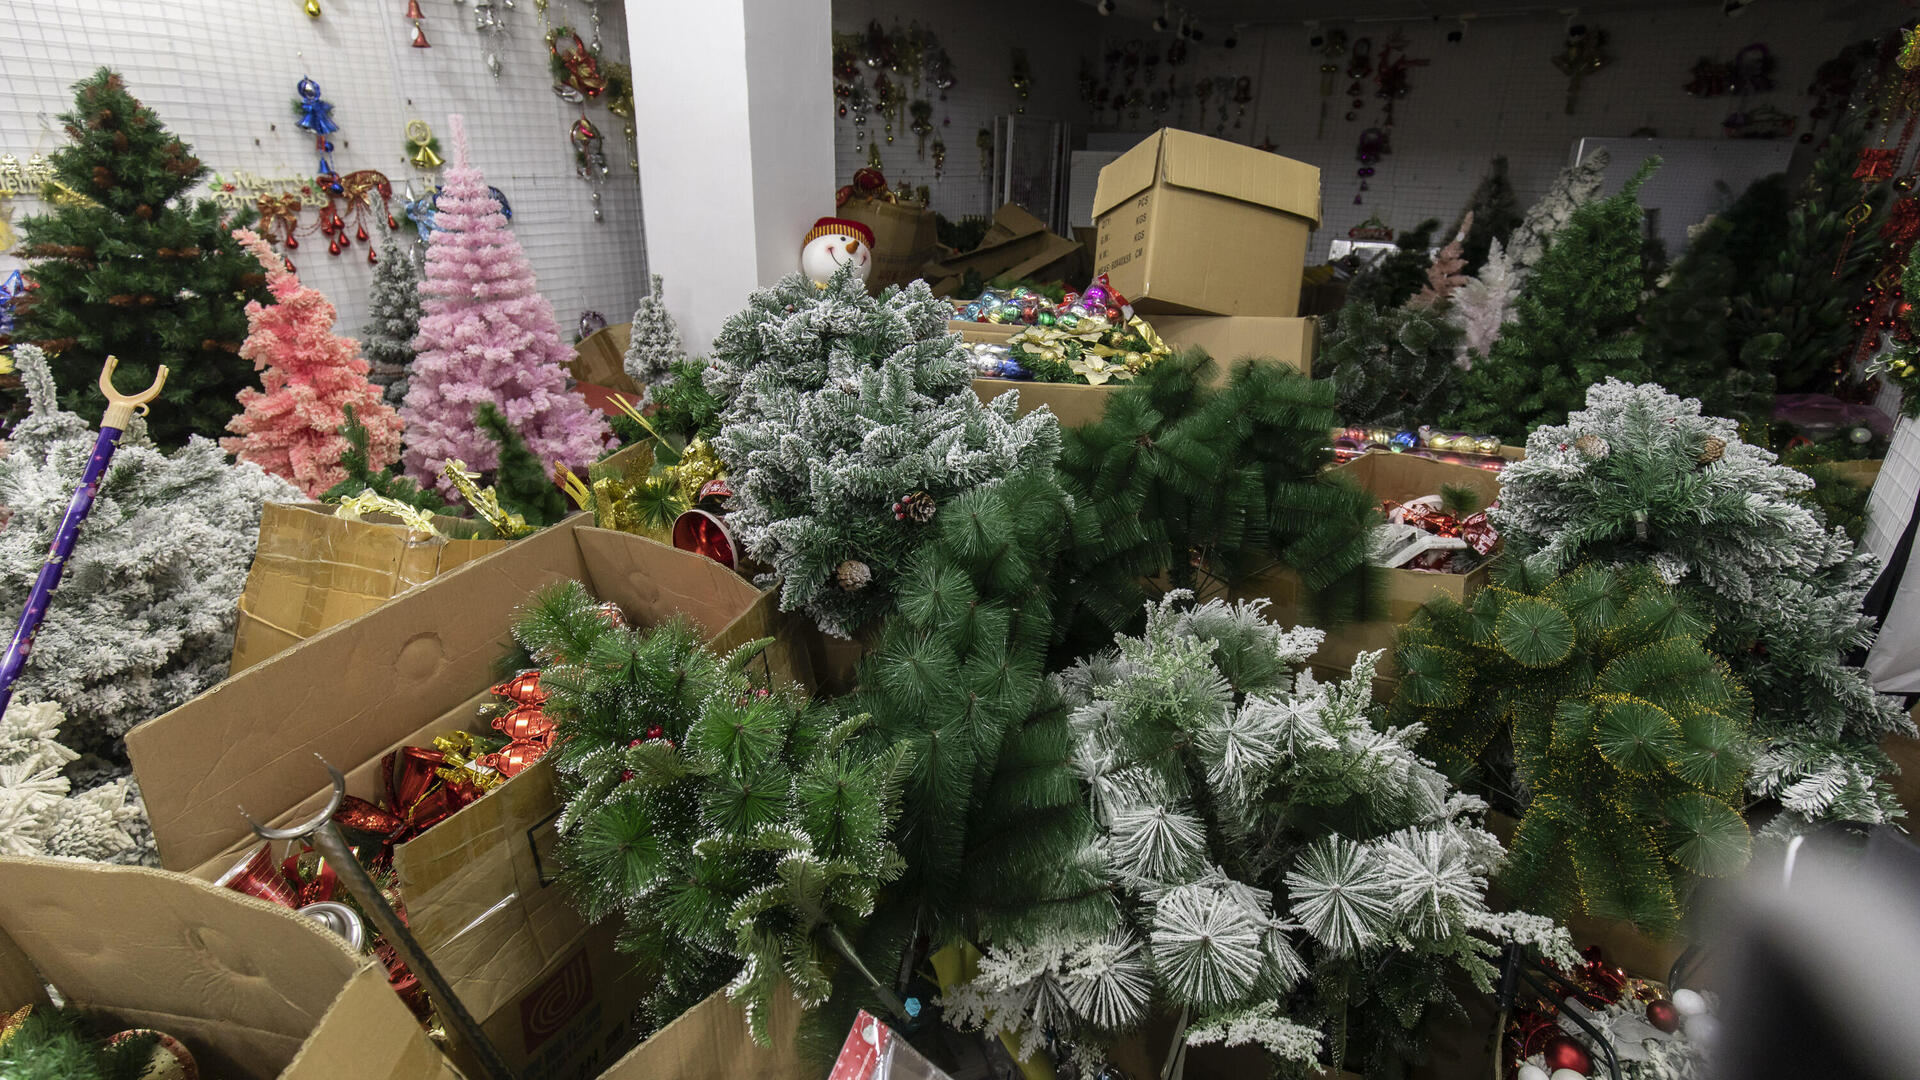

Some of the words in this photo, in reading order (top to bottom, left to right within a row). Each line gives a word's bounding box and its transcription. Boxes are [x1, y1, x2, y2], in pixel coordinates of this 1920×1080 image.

[1138, 196, 1149, 208] PCS
[1136, 214, 1147, 225] KGS
[1135, 231, 1145, 242] KGS
